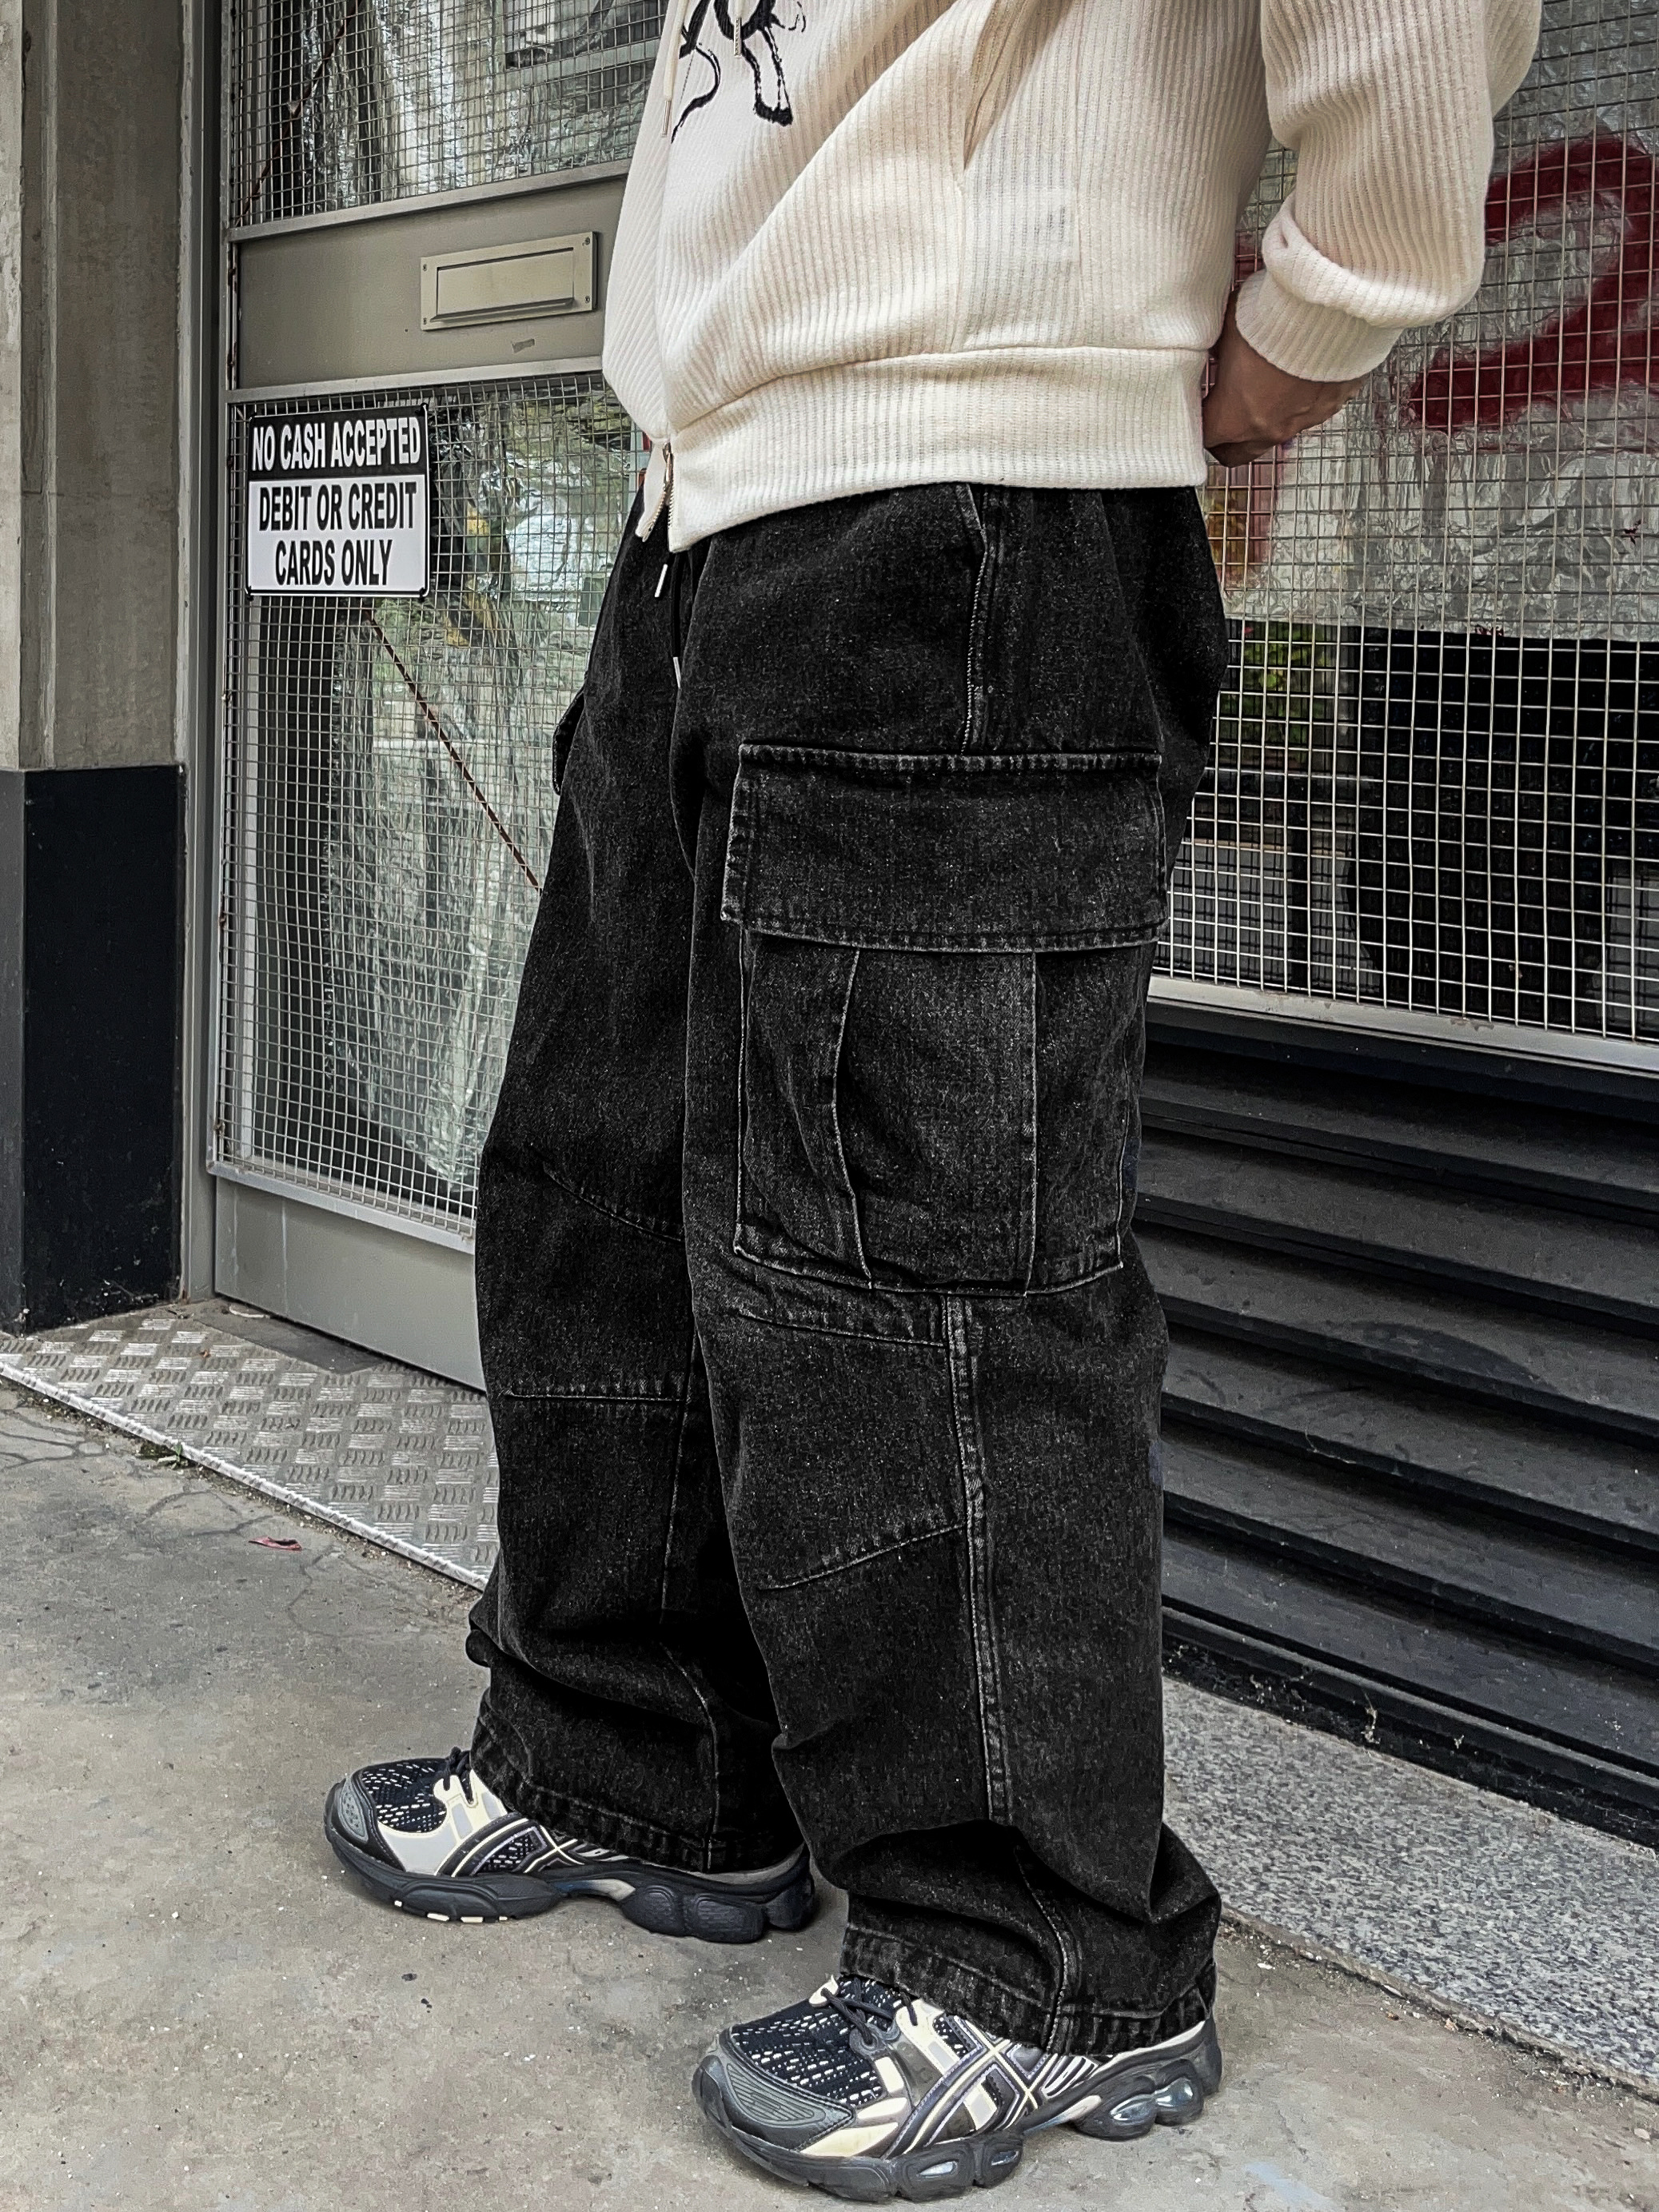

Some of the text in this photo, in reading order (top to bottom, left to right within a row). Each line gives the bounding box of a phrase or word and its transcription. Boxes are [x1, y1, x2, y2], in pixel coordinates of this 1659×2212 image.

[252, 416, 421, 471] NO CASH ACCEPTED
[259, 481, 417, 531] DEBIT OR CREDIT
[275, 539, 393, 586] CARDS ONLY
